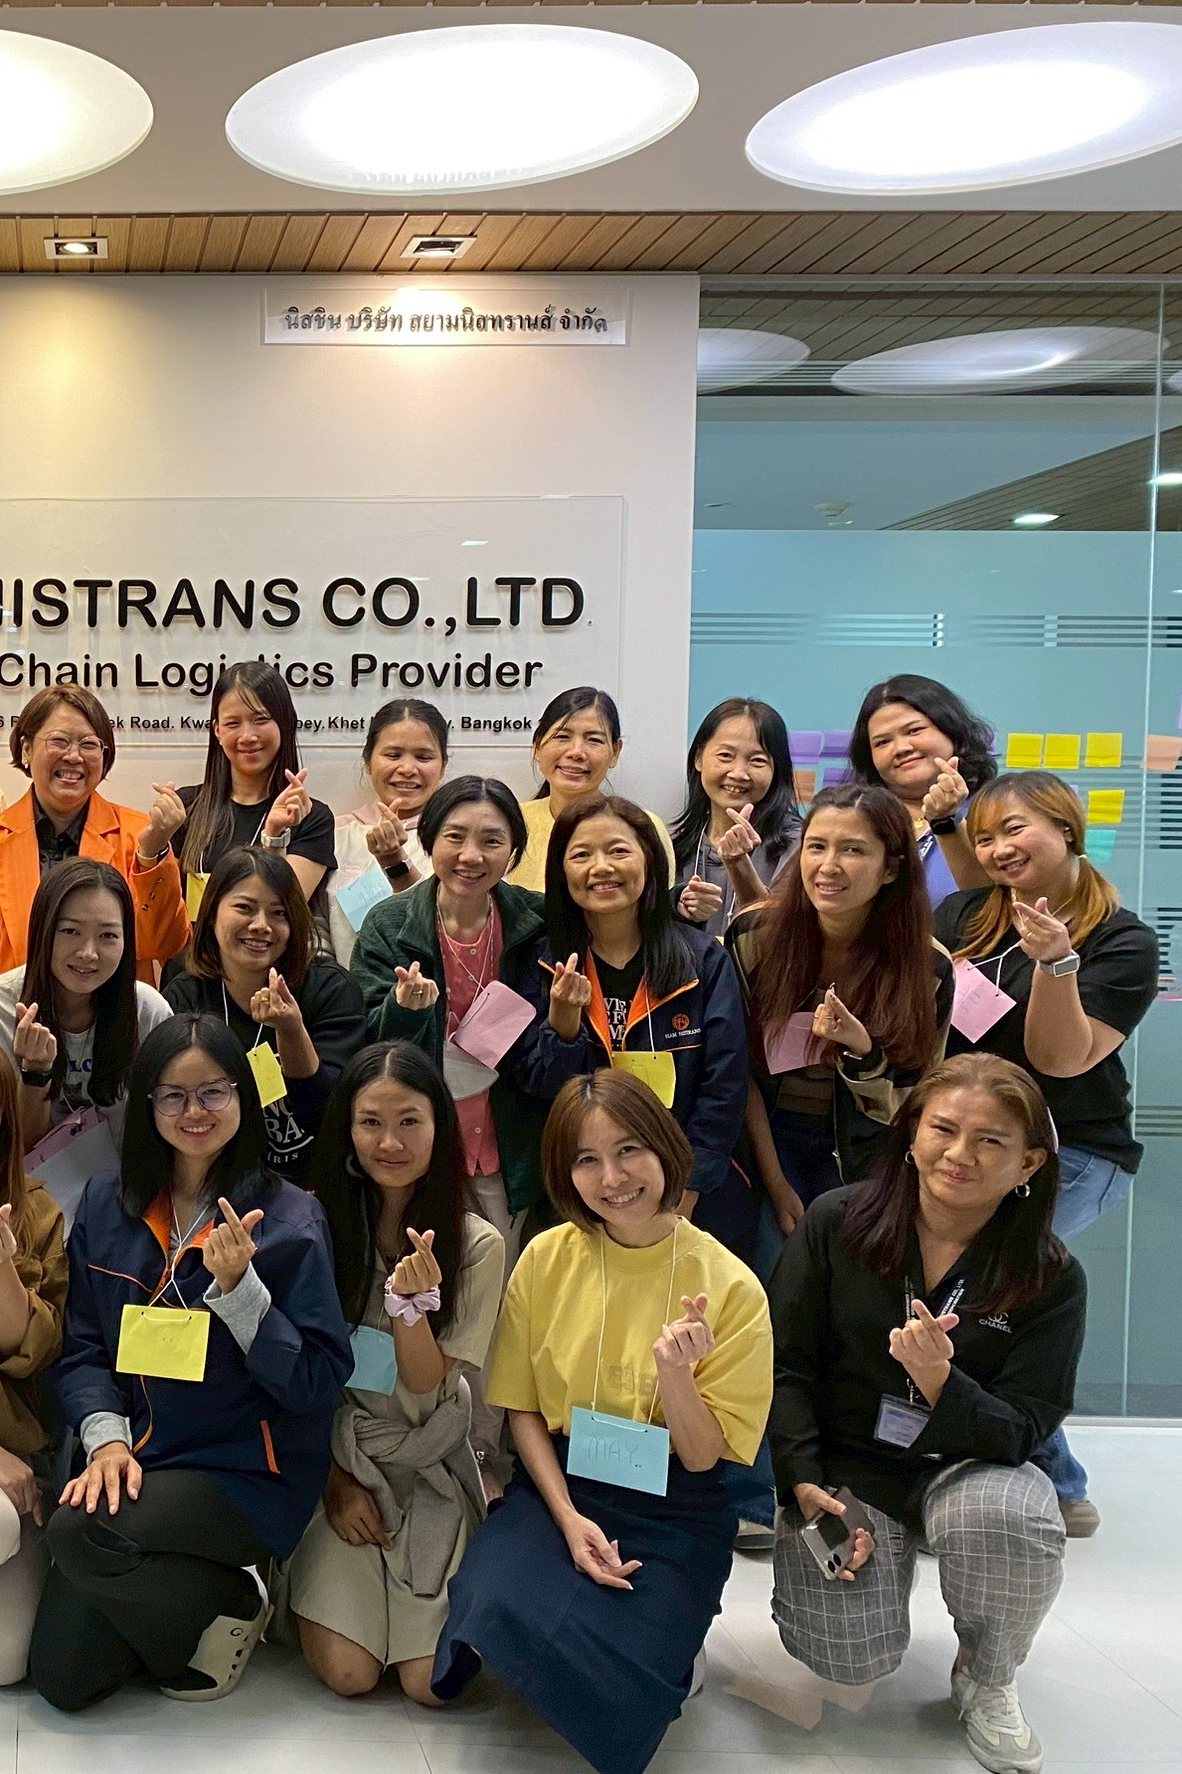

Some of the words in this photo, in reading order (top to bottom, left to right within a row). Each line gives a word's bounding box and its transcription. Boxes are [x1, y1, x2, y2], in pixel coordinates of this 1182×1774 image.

[285, 306, 341, 330] นิสชิน
[348, 306, 403, 331] บริษัท
[559, 307, 608, 333] จำกัด
[351, 652, 543, 689] Provider
[130, 716, 175, 729] Road.
[328, 716, 365, 729] Khet
[461, 716, 532, 733] Bangkok
[978, 1318, 1013, 1334] CHANEL
